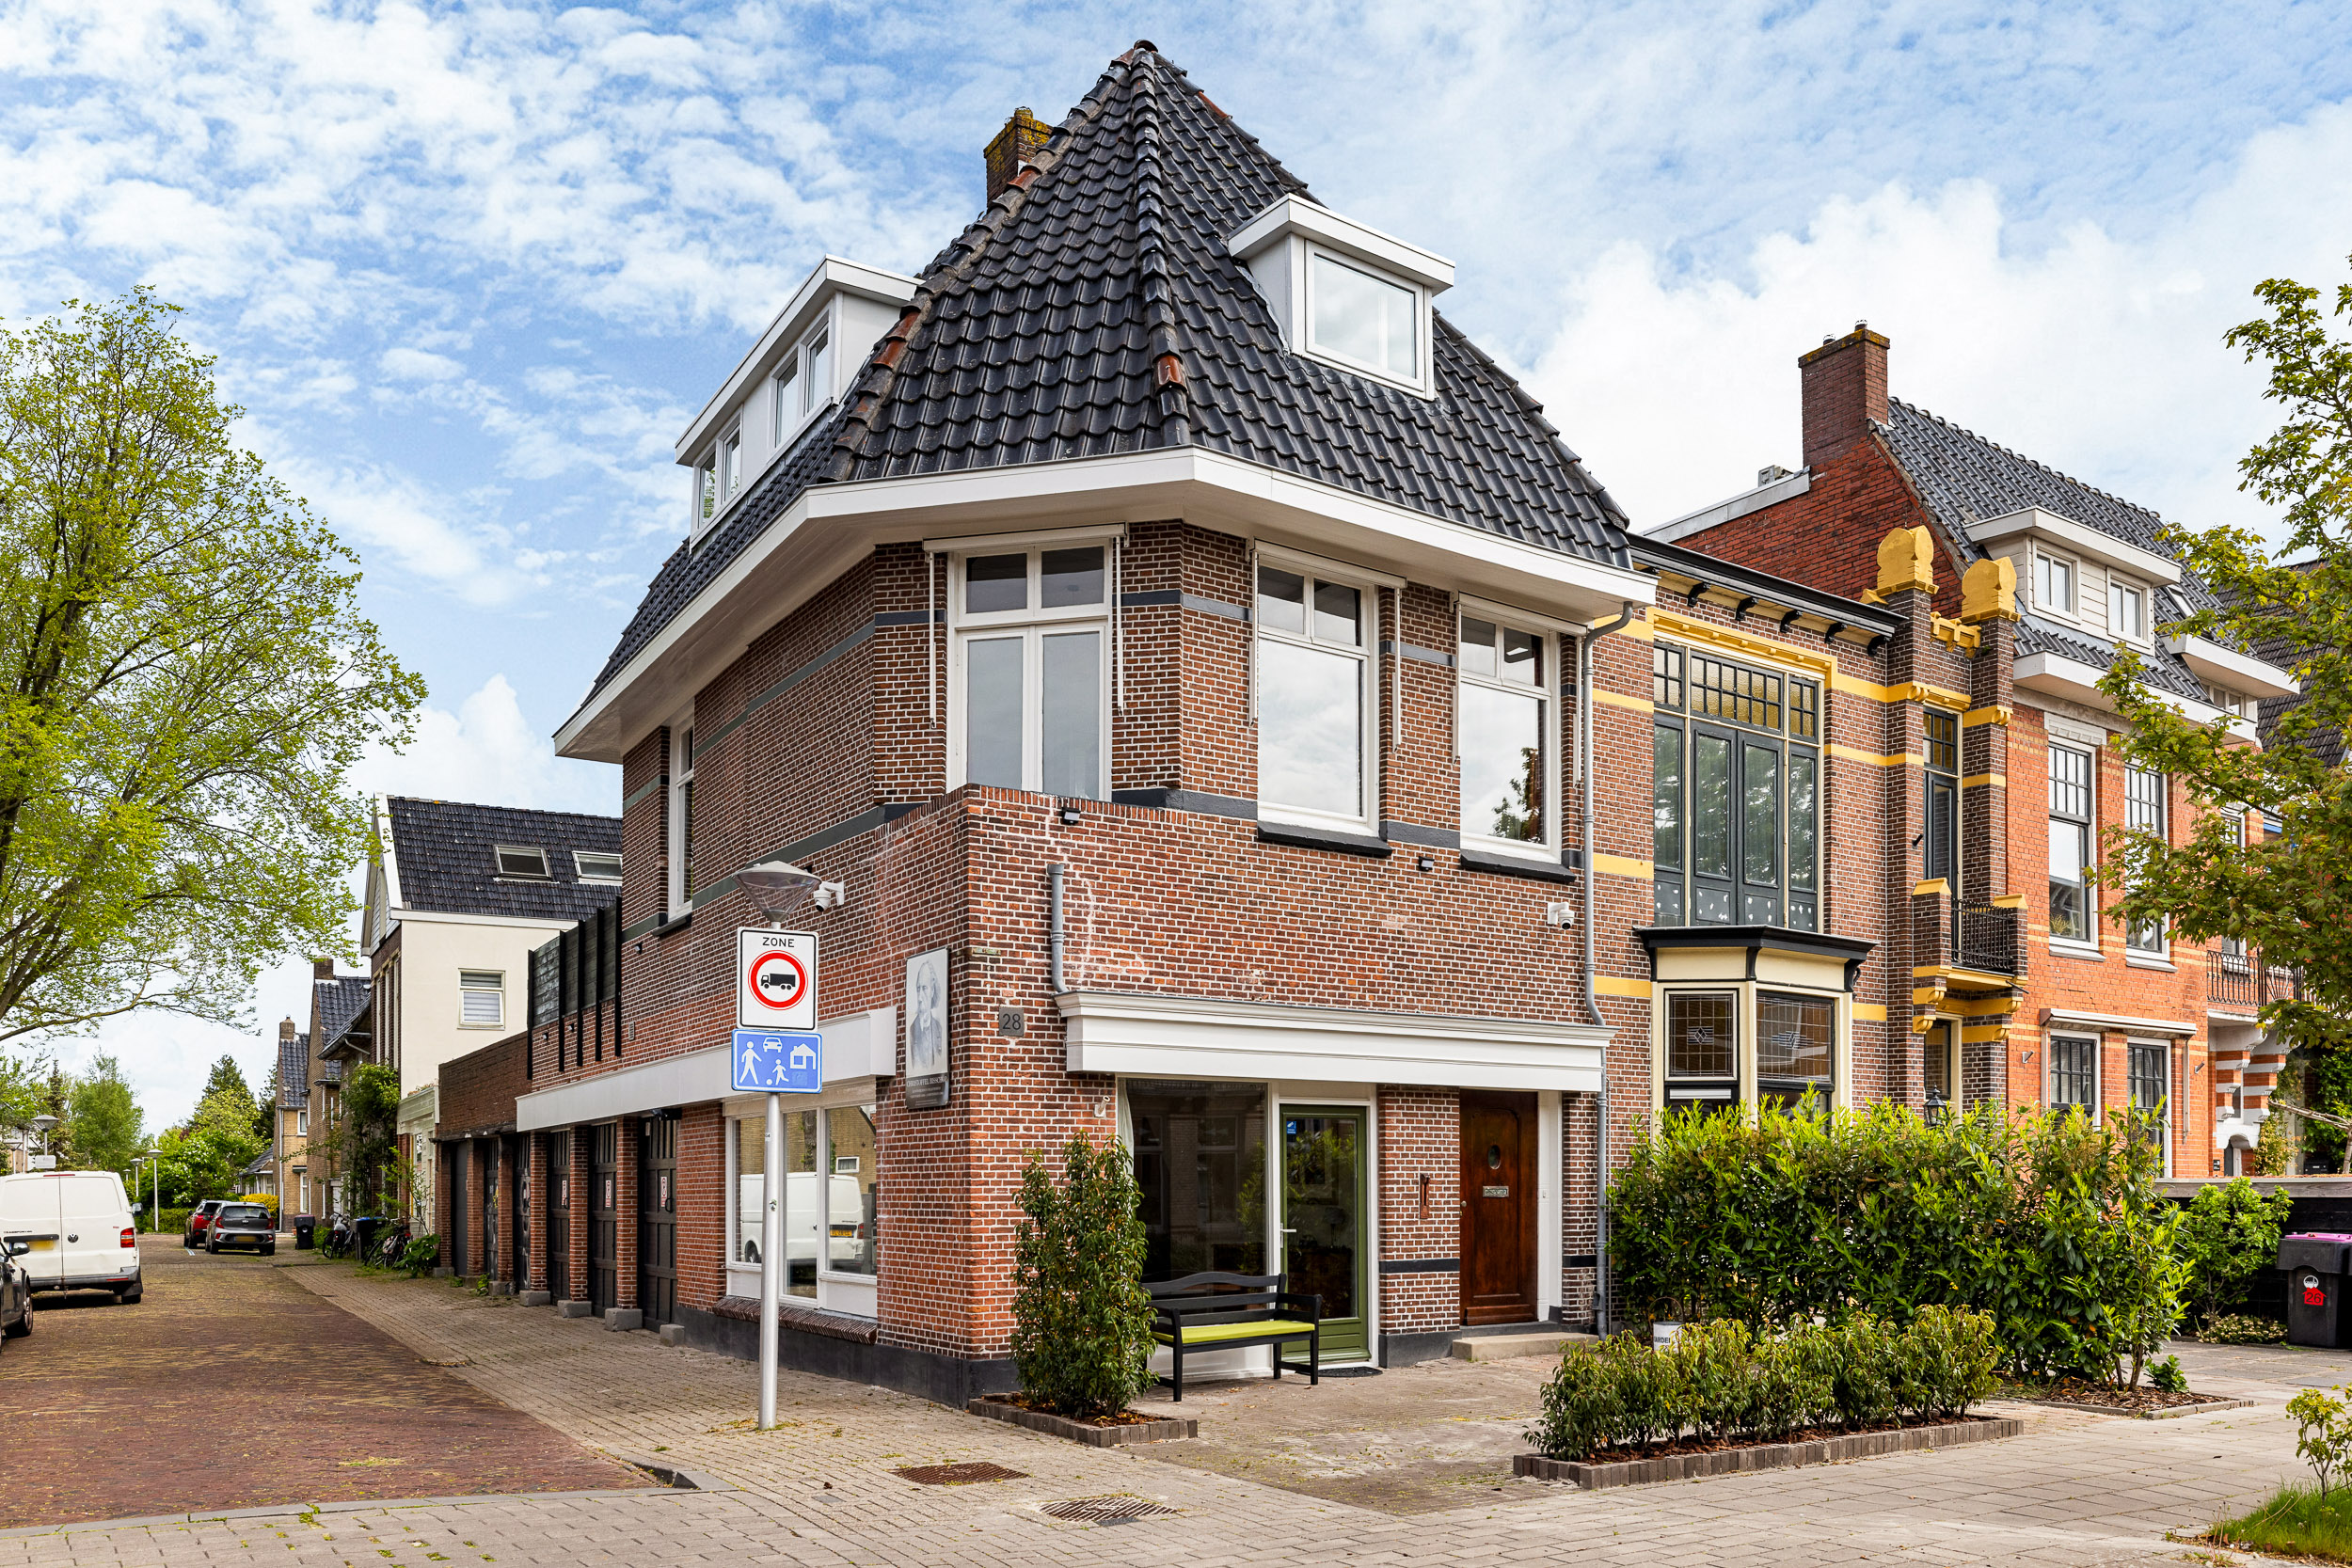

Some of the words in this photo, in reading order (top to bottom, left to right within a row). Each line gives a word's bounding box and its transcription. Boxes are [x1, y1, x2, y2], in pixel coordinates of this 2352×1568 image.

[762, 937, 795, 947] ZONE
[1002, 1013, 1022, 1031] 28
[2305, 1291, 2322, 1305] 26
